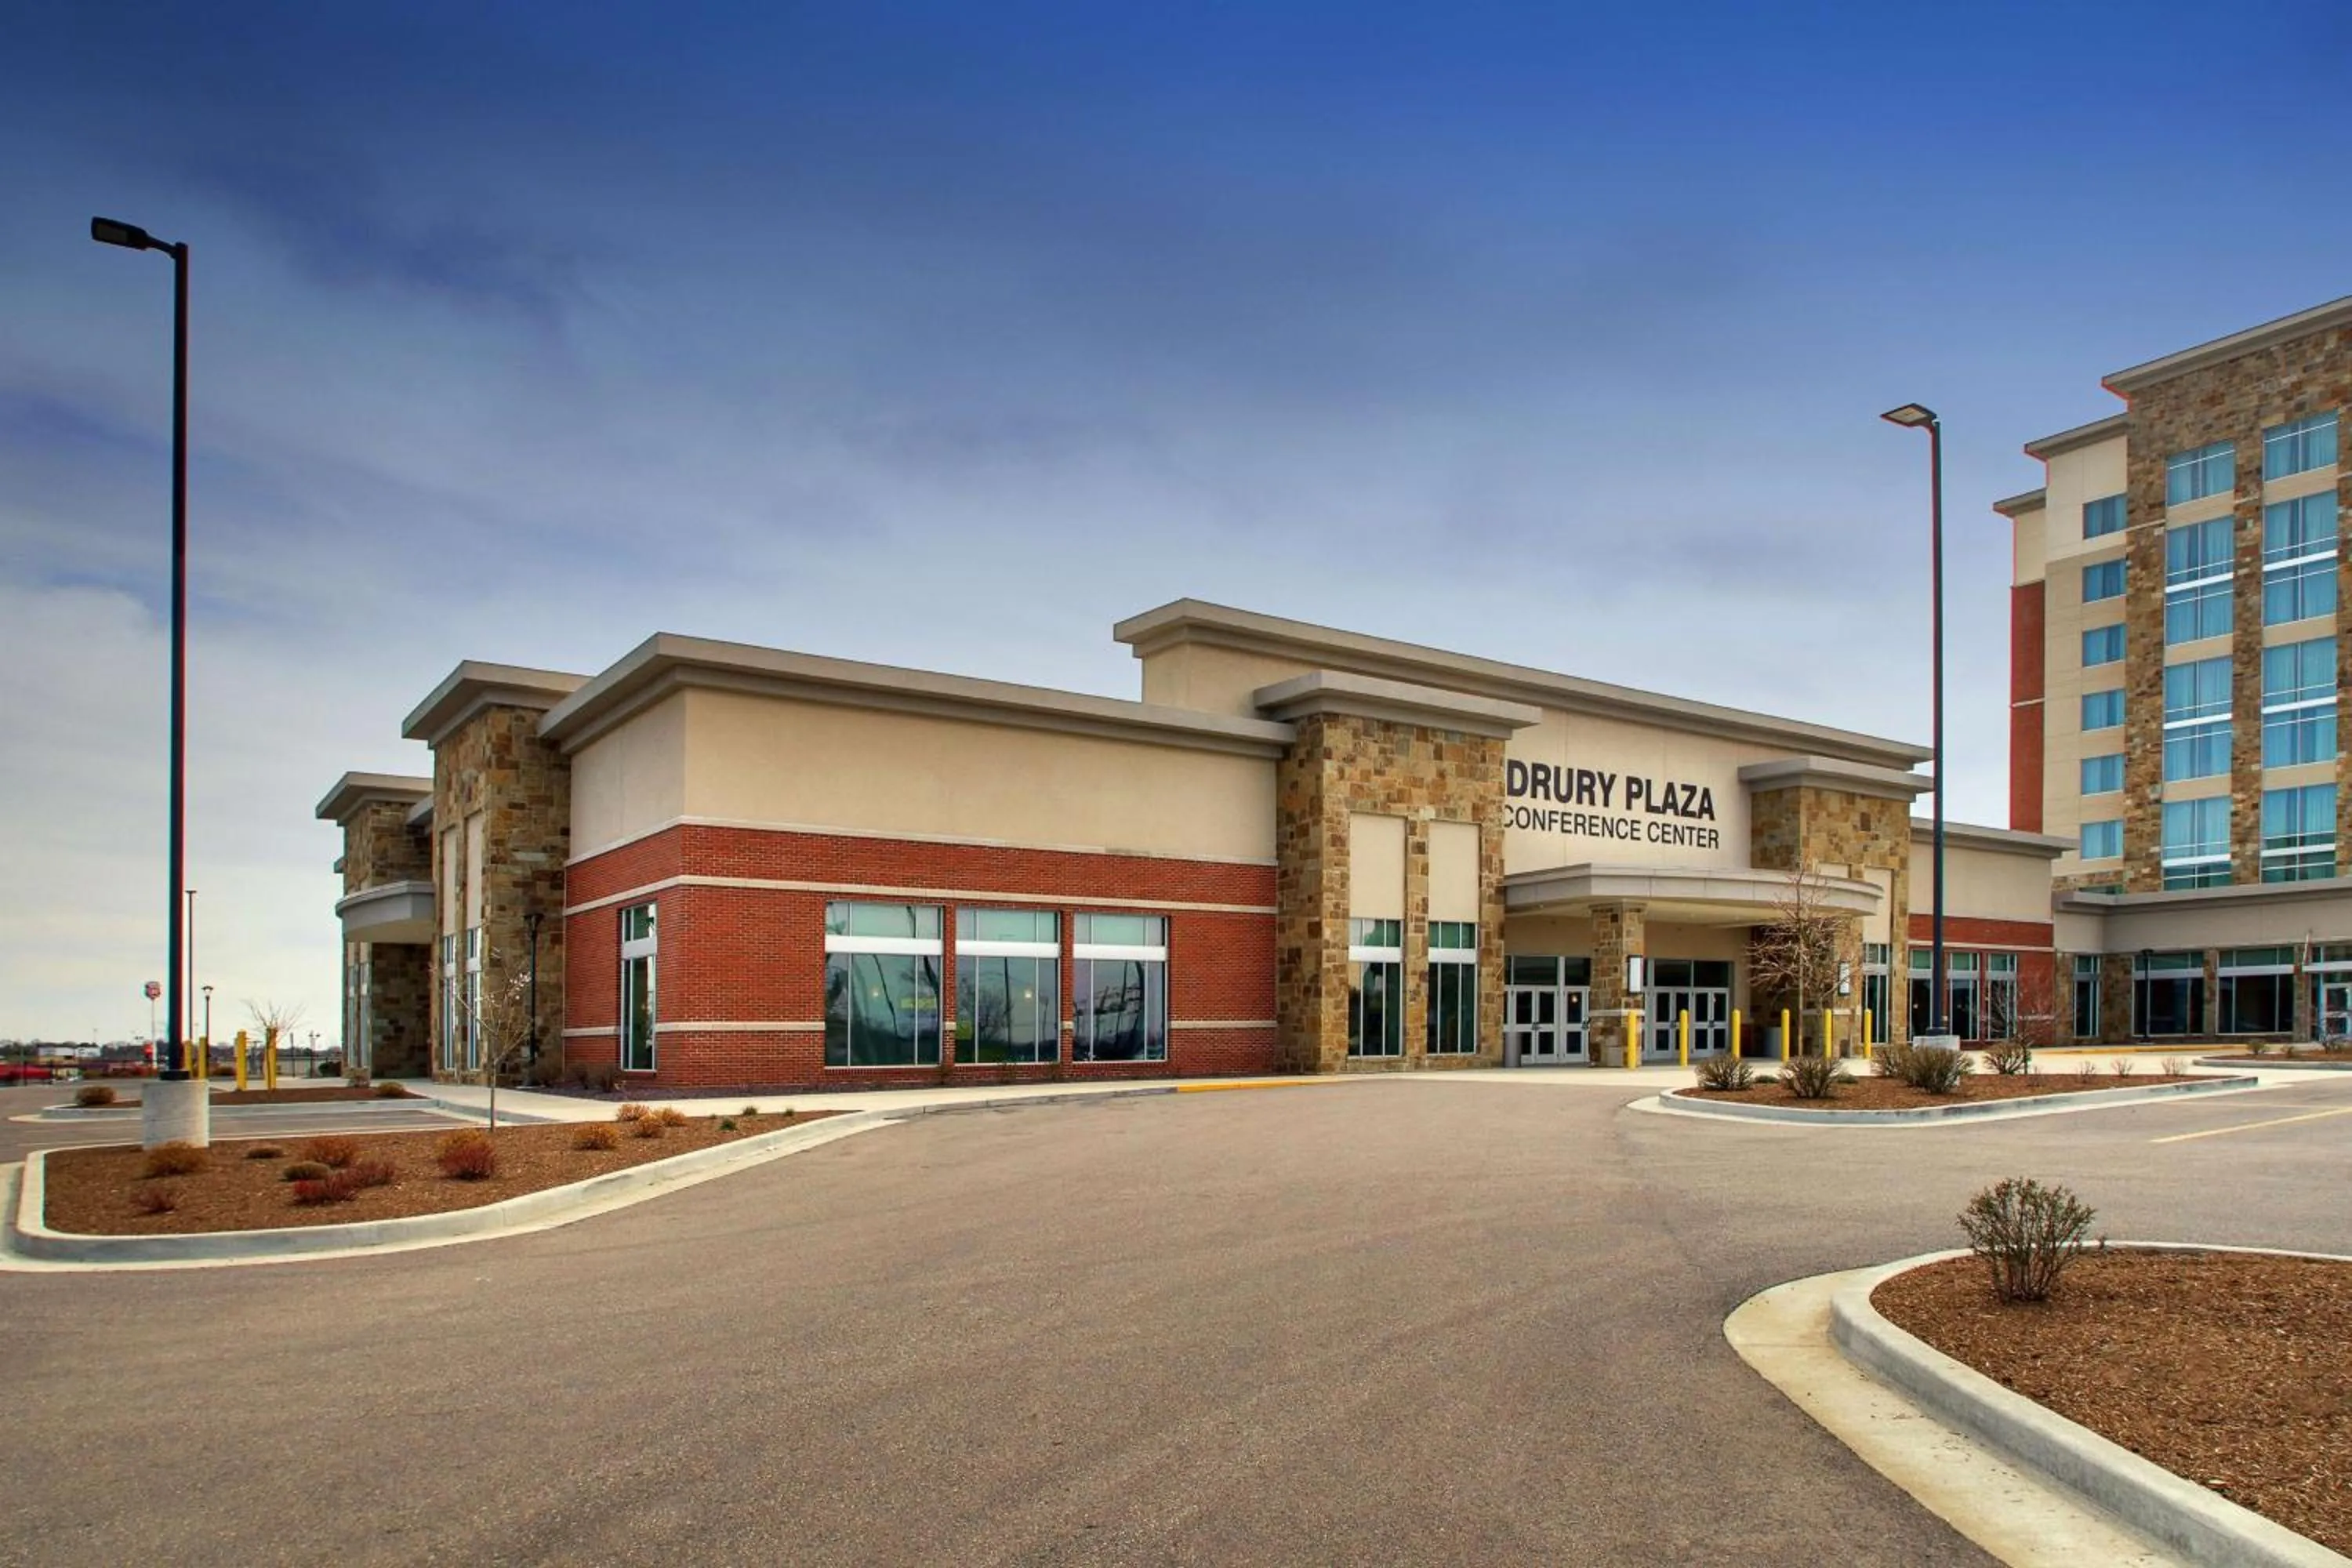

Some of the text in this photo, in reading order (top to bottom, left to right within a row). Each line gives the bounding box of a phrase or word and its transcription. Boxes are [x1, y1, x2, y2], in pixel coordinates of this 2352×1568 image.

[1507, 759, 1715, 821] DRURY PLAZA
[1504, 804, 1719, 849] CONFERENCE CENTER
